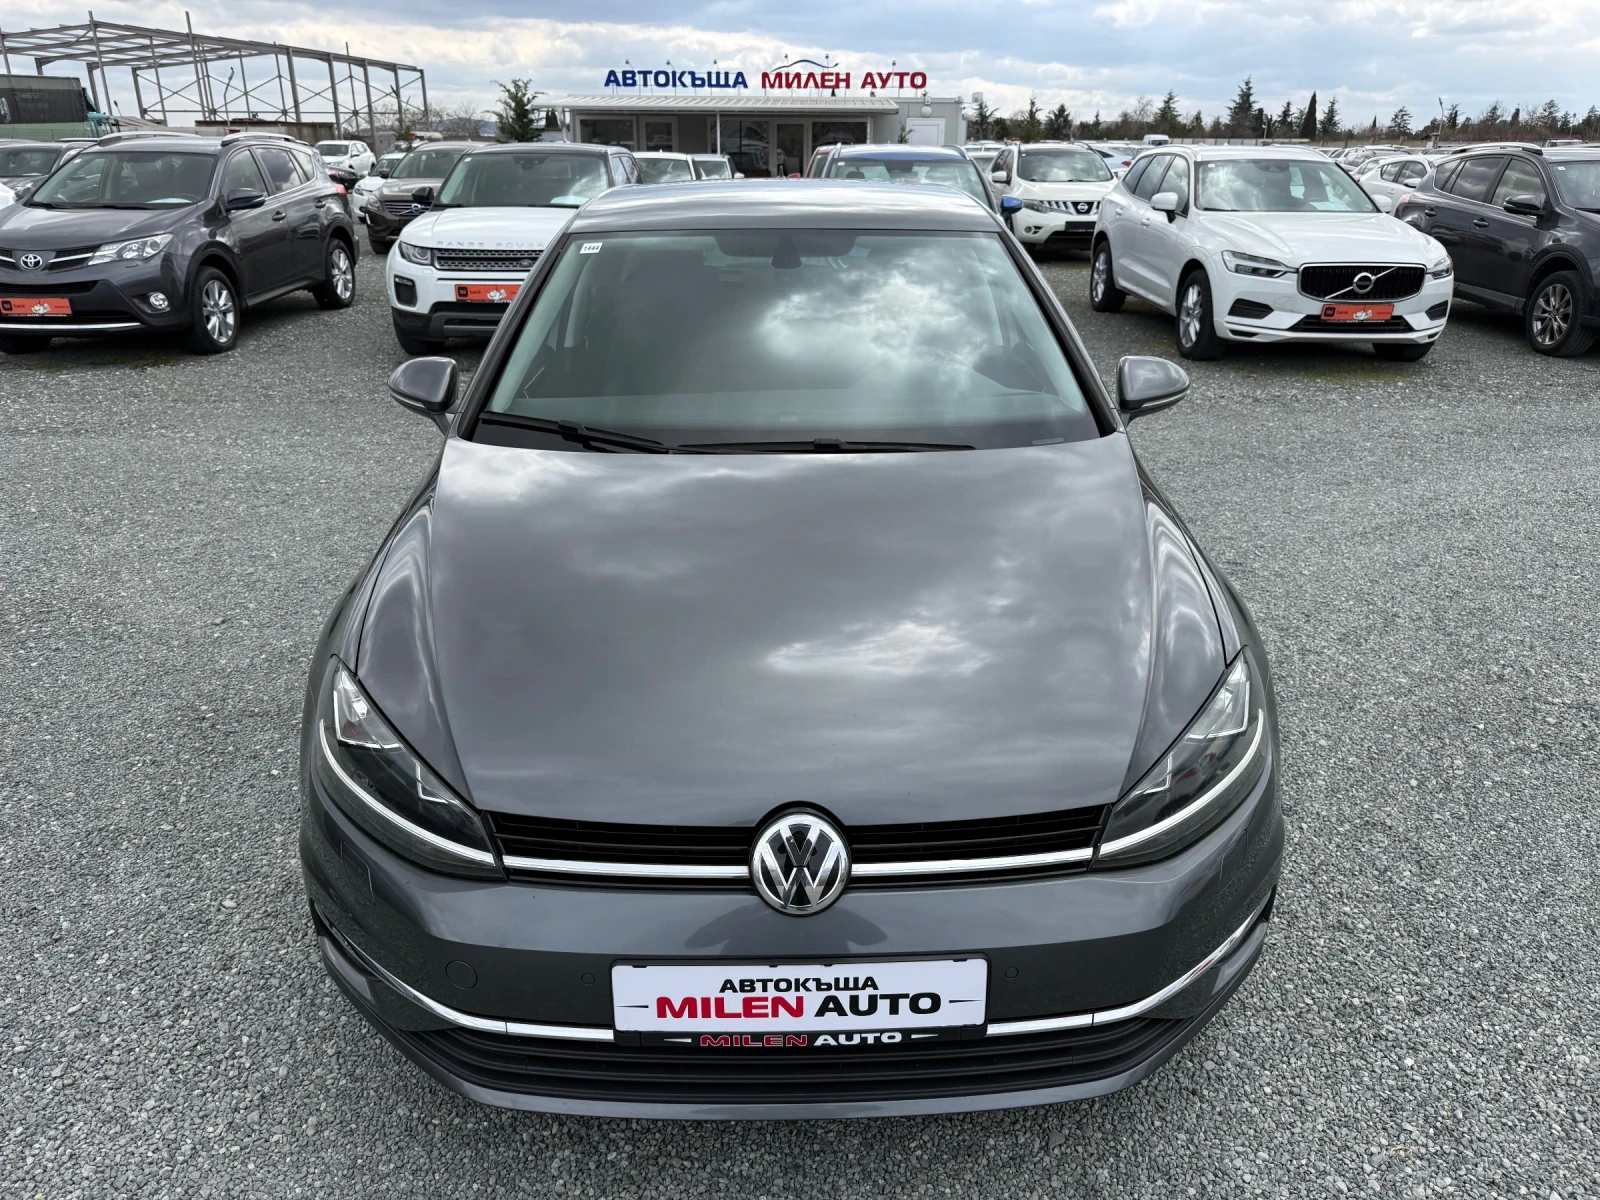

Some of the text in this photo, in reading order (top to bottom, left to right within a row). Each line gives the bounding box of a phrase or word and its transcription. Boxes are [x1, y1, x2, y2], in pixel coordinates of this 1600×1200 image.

[761, 71, 850, 89] МИЛЕН
[860, 71, 927, 89] АУТО
[436, 240, 485, 248] RANGE
[656, 992, 942, 1019] MILEN AUTO
[700, 1031, 902, 1047] MILEN AUTO
